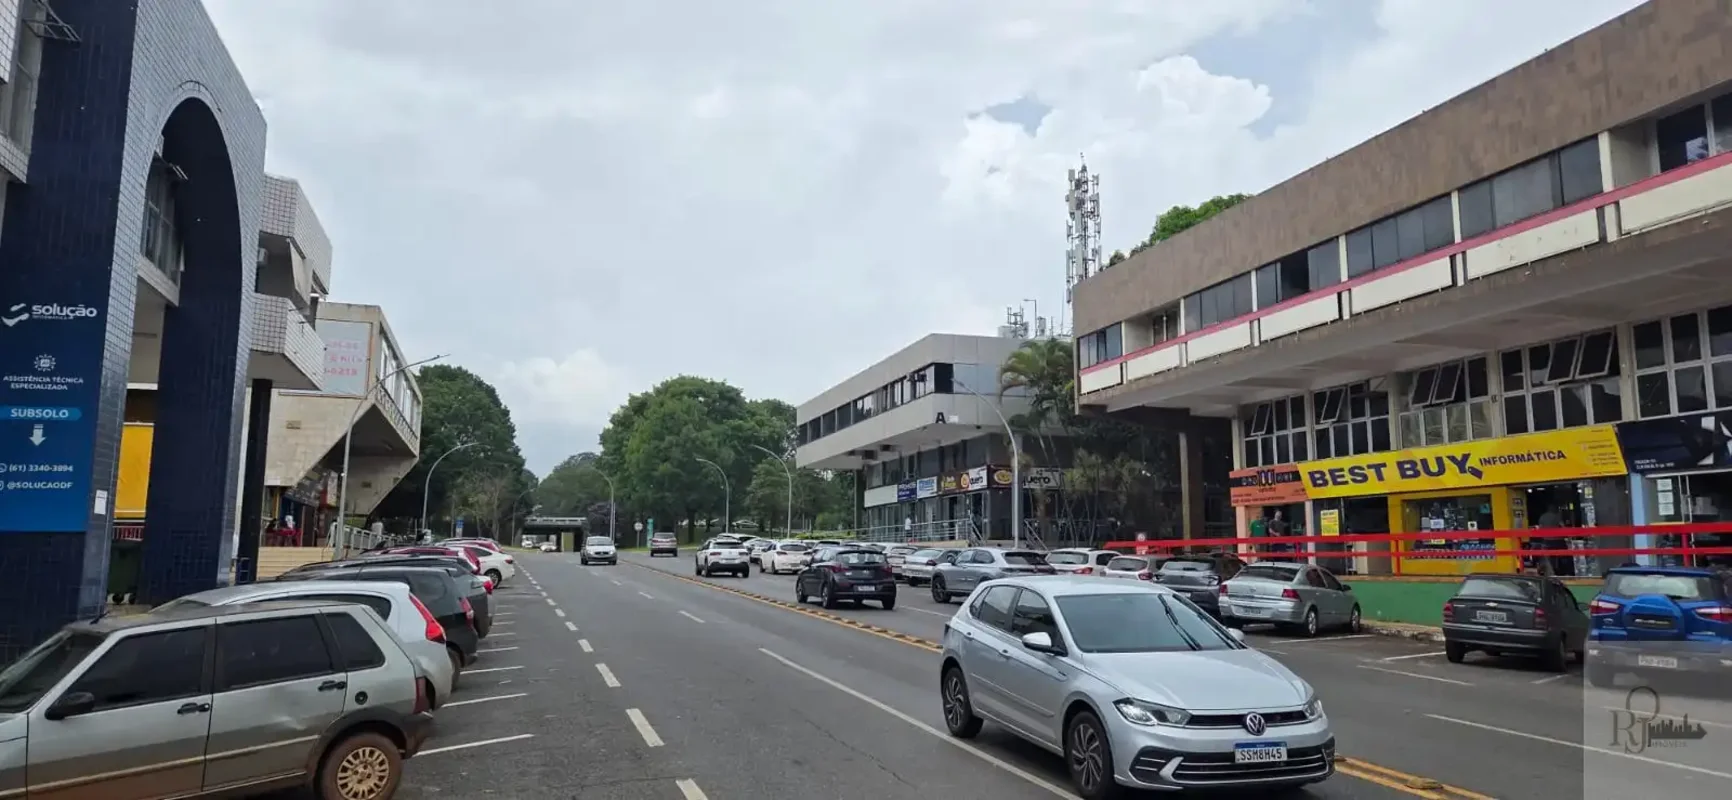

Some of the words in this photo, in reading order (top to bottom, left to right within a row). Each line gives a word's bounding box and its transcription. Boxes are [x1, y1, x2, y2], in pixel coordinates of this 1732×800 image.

[31, 303, 98, 319] solução
[3, 375, 51, 383] ASSISTÊNCIA
[52, 376, 84, 384] TÉCNICA
[10, 382, 68, 391] ESPECIALIZADA
[10, 408, 69, 418] SUBSOLO
[935, 411, 947, 424] A
[1307, 462, 1387, 488] BEST
[1396, 453, 1471, 480] BUY
[1479, 450, 1567, 466] INFORMÁTICA
[1240, 748, 1283, 761] SSM8H45
